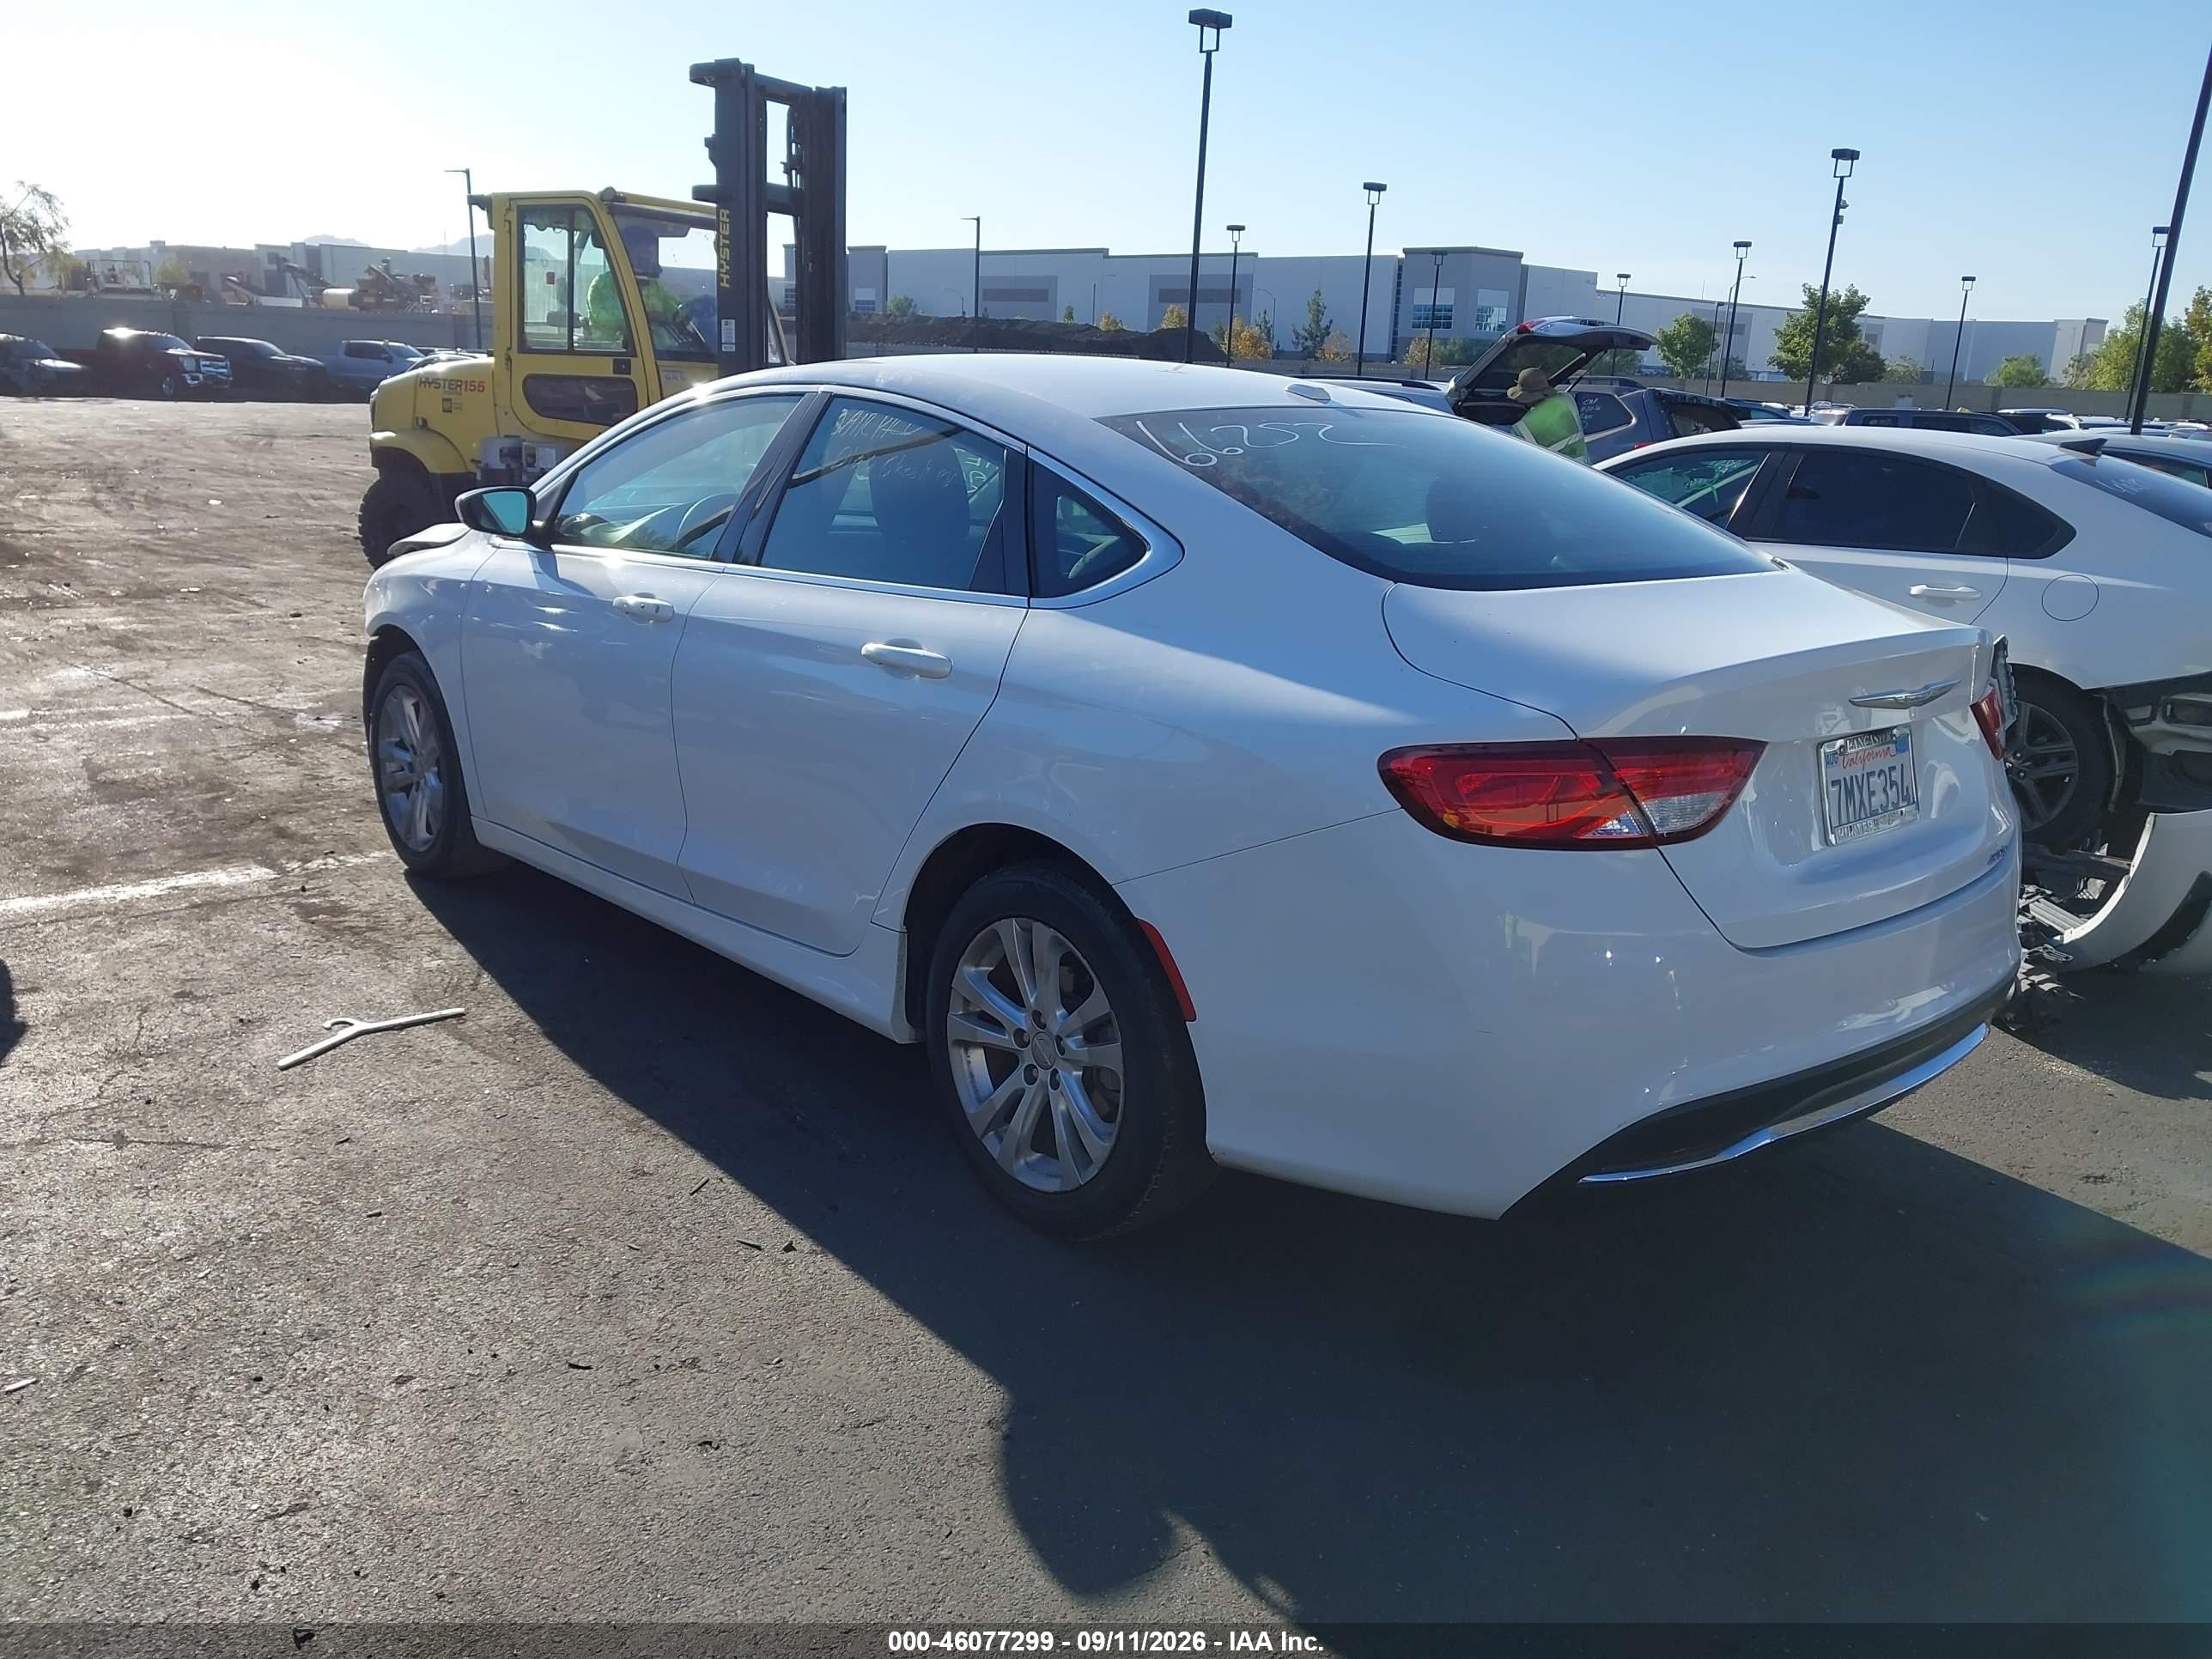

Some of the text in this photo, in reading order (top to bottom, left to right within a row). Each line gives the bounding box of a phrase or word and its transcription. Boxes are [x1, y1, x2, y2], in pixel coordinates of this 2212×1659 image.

[719, 208, 730, 289] HYSTER
[1842, 746, 1897, 771] California
[1831, 763, 1911, 825] 7MXE354
